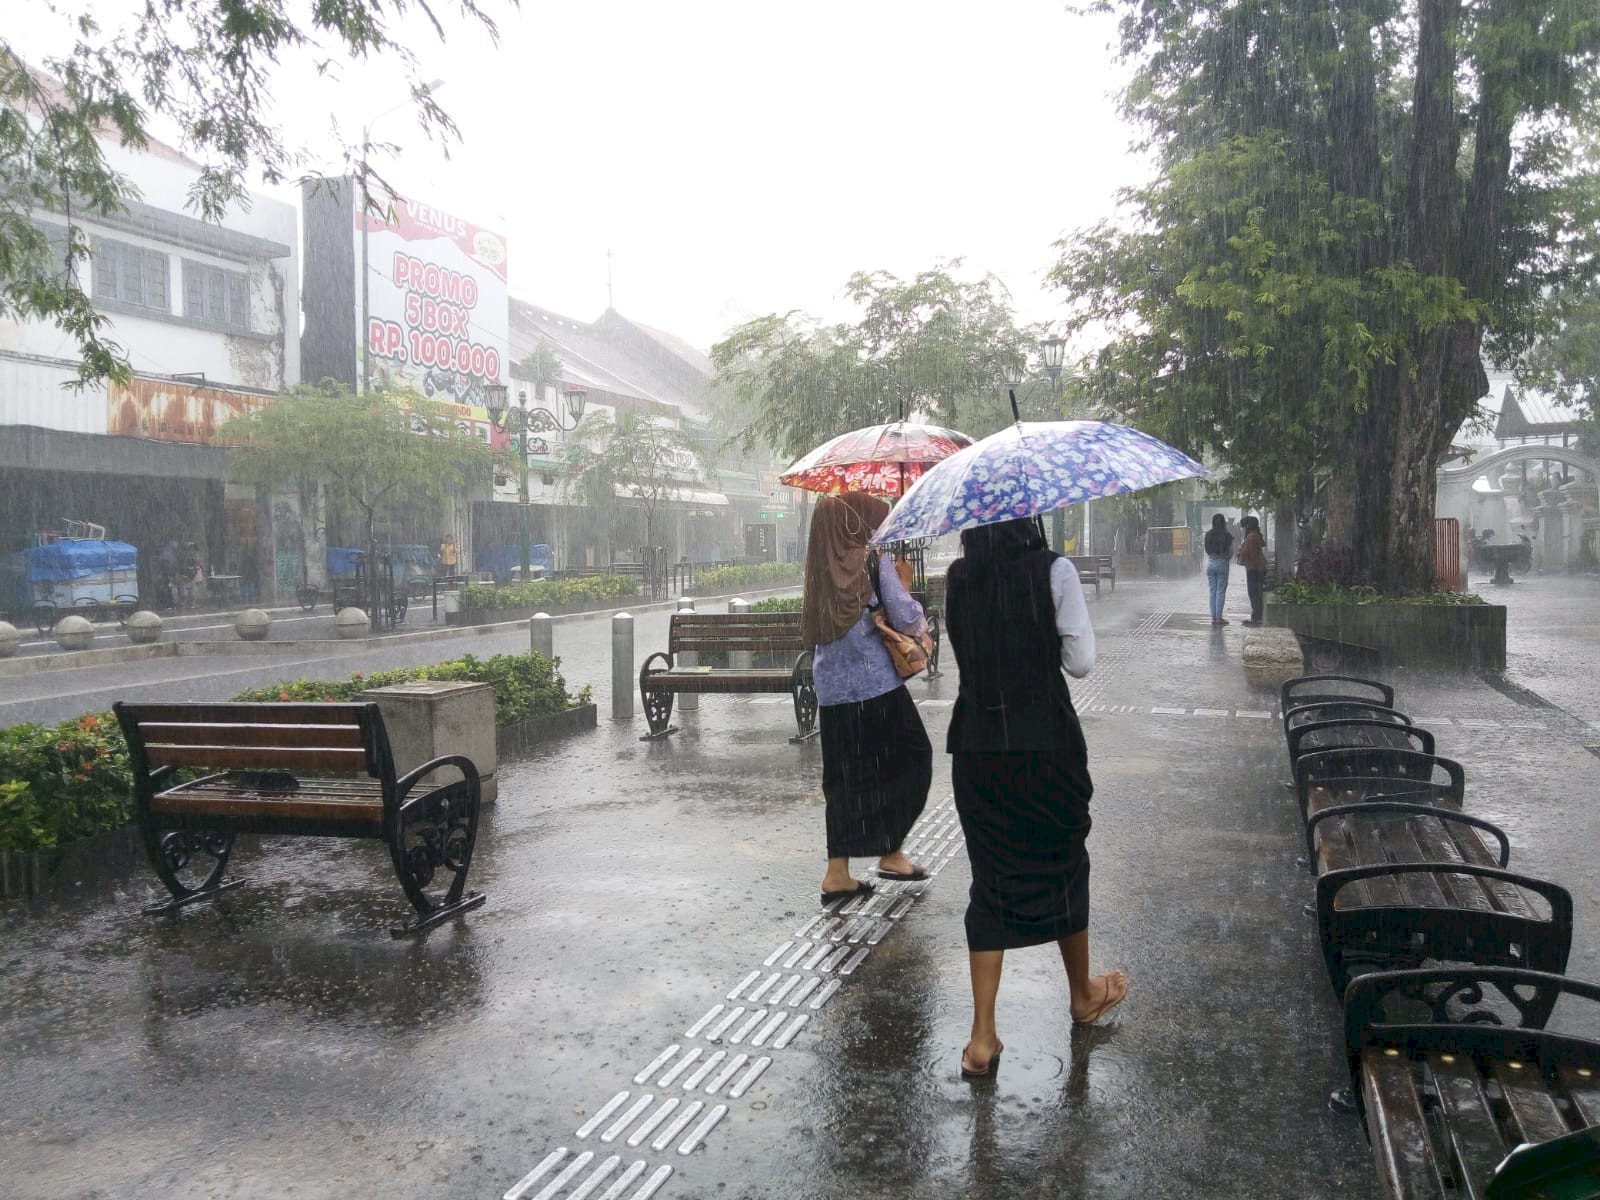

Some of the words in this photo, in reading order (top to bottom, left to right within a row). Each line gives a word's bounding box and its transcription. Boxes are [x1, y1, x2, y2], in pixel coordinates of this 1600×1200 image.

[406, 199, 467, 237] VENUS
[393, 252, 477, 308] PROMO
[369, 318, 407, 361] RP.
[409, 330, 500, 378] 100.000
